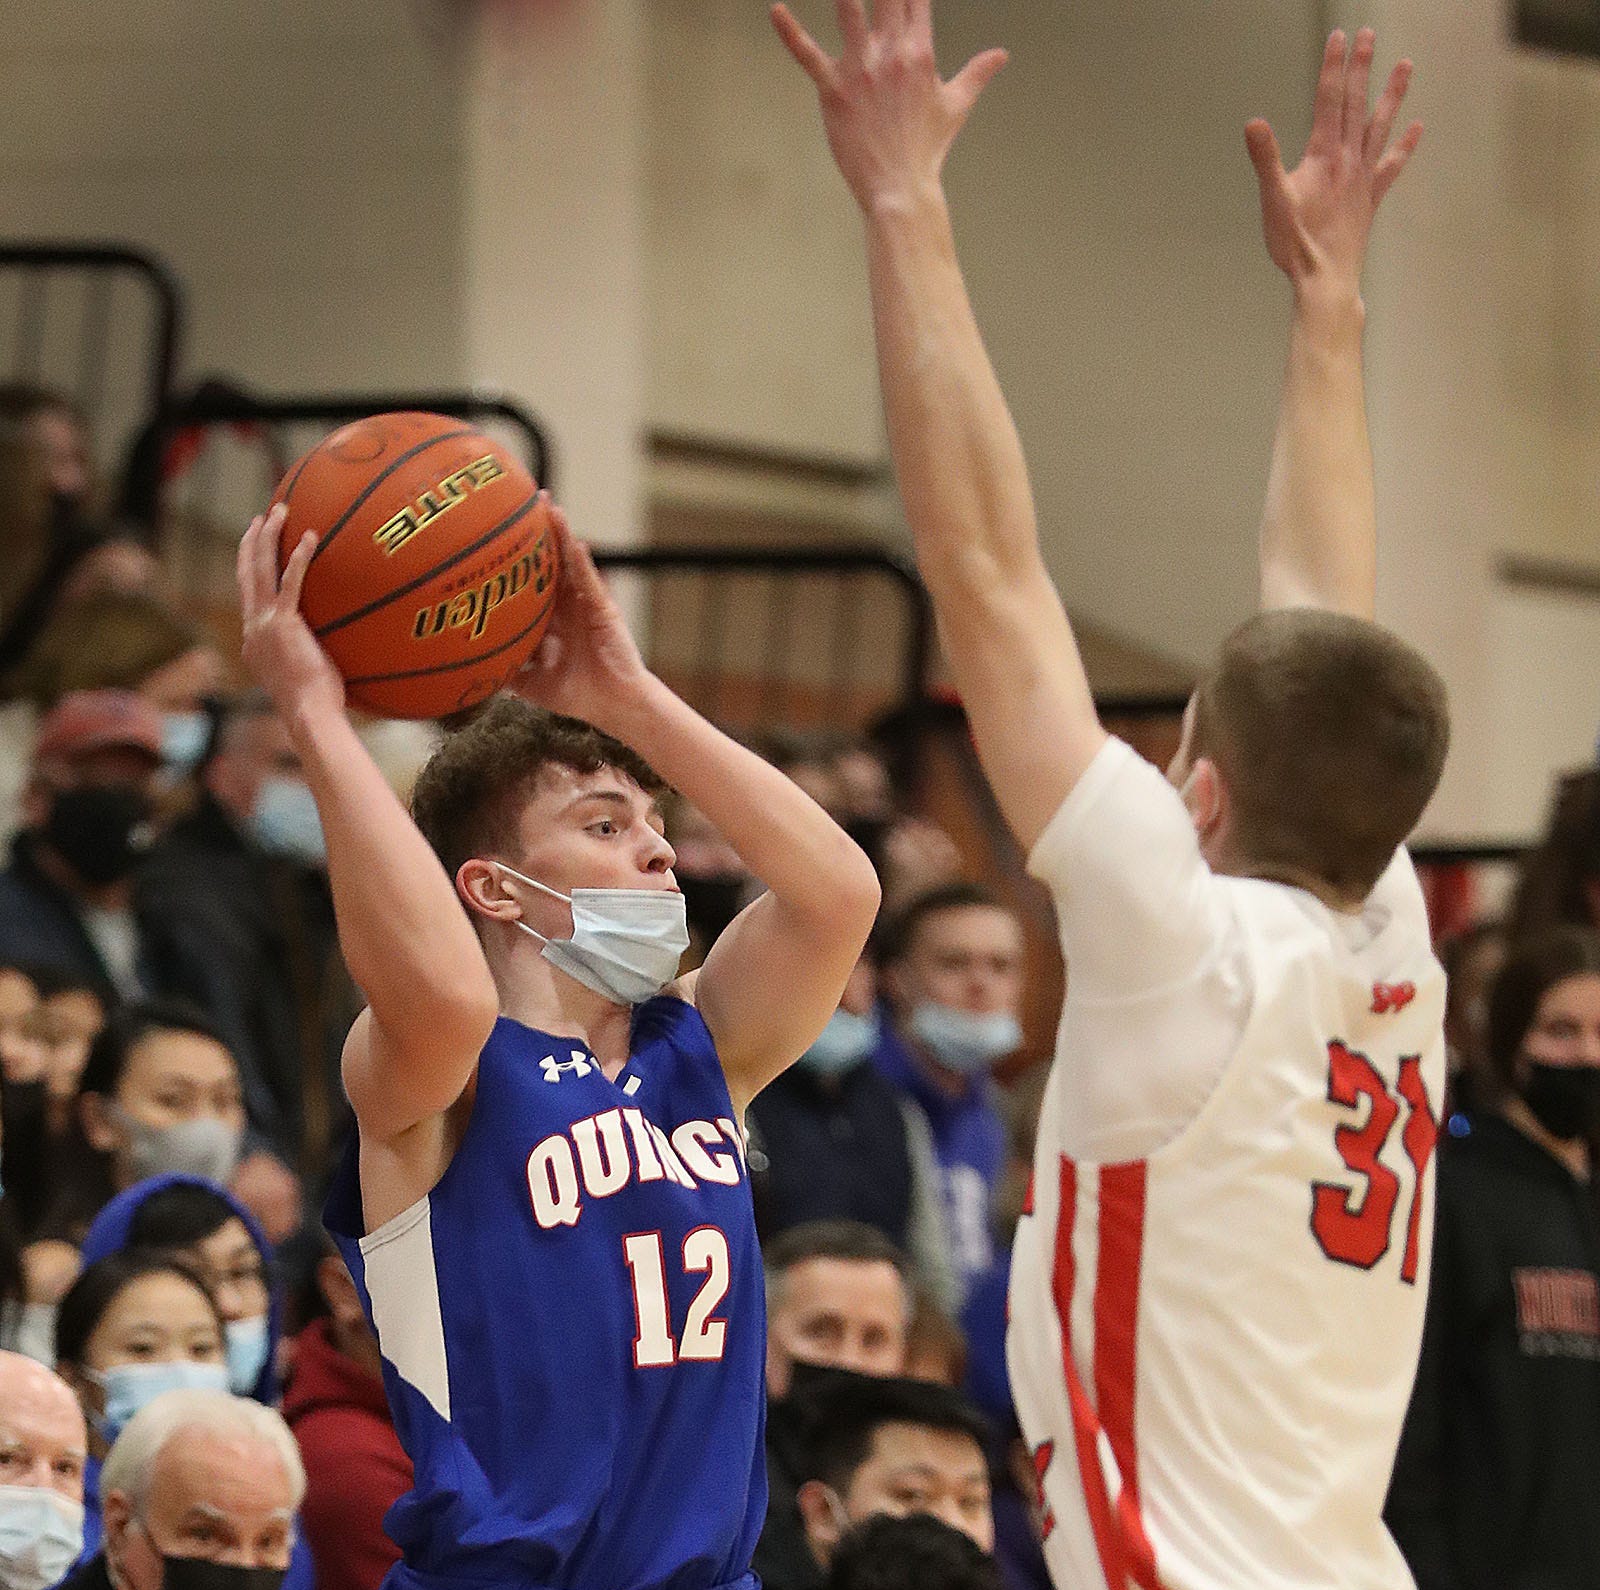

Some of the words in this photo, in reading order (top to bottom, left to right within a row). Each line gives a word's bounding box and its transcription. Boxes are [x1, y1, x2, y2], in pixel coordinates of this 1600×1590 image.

[372, 453, 508, 558] ELITE
[411, 532, 553, 641] Baden
[1310, 1037, 1442, 1286] 31
[622, 1223, 735, 1370] 12
